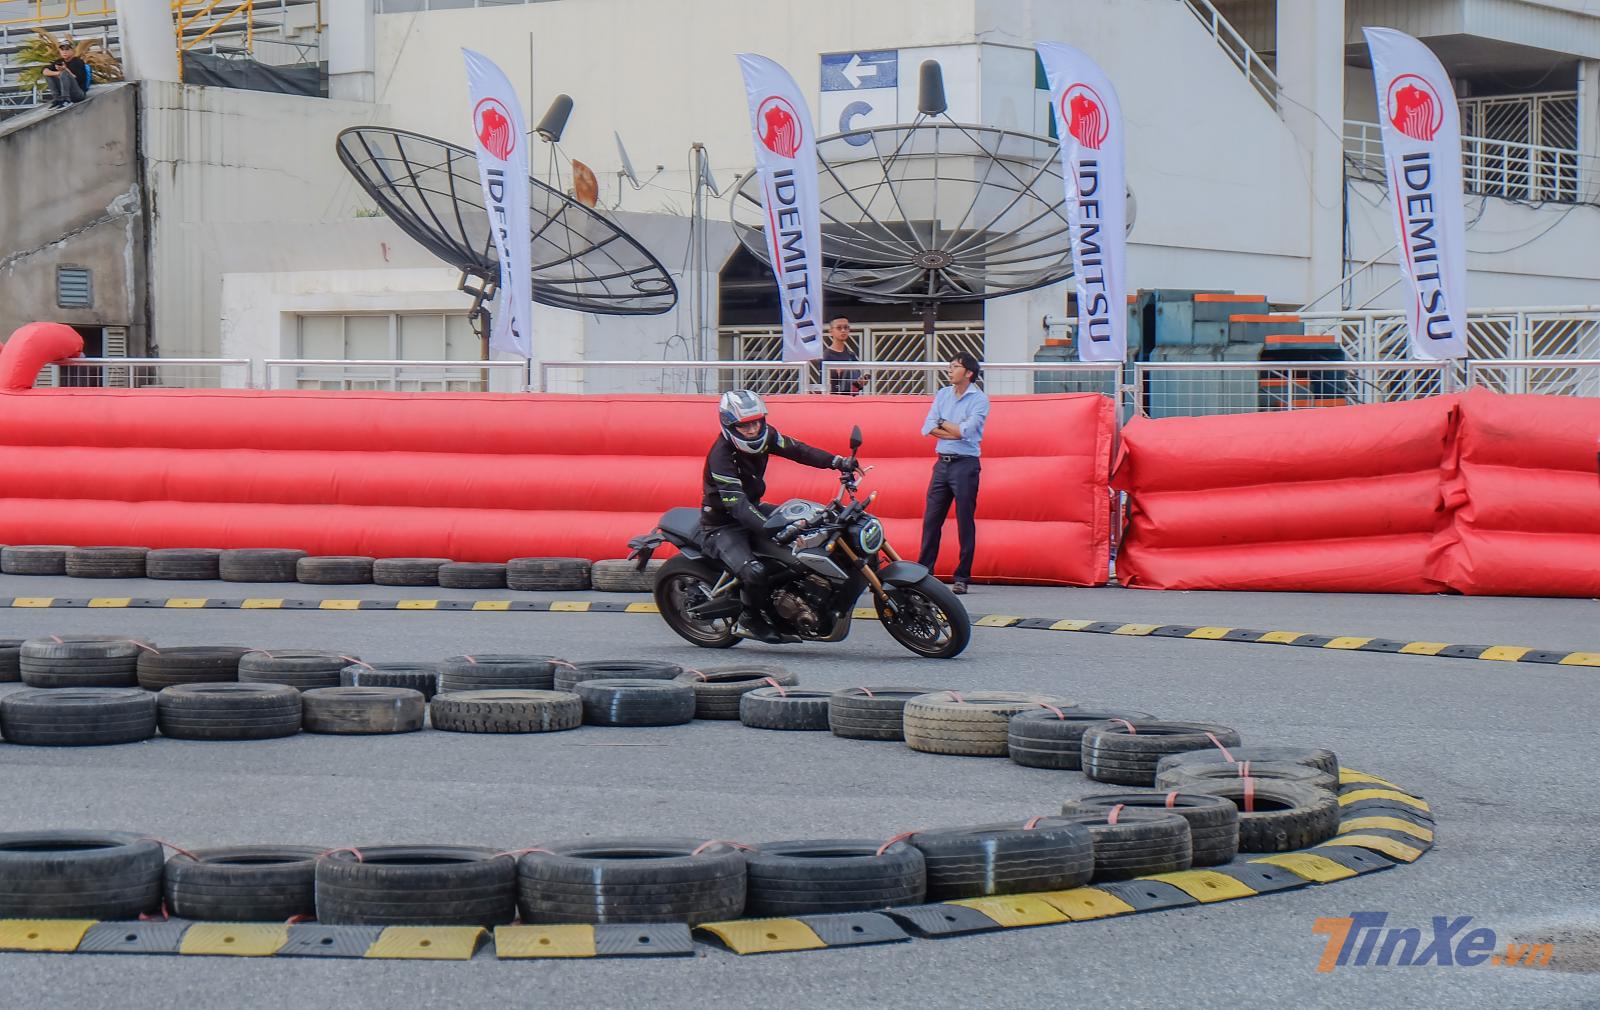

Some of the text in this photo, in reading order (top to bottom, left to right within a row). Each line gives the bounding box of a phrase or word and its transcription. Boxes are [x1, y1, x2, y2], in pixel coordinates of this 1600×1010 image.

[839, 100, 873, 147] C
[1079, 160, 1111, 343] IDEMITSU
[1402, 152, 1453, 340] IDEMITSU
